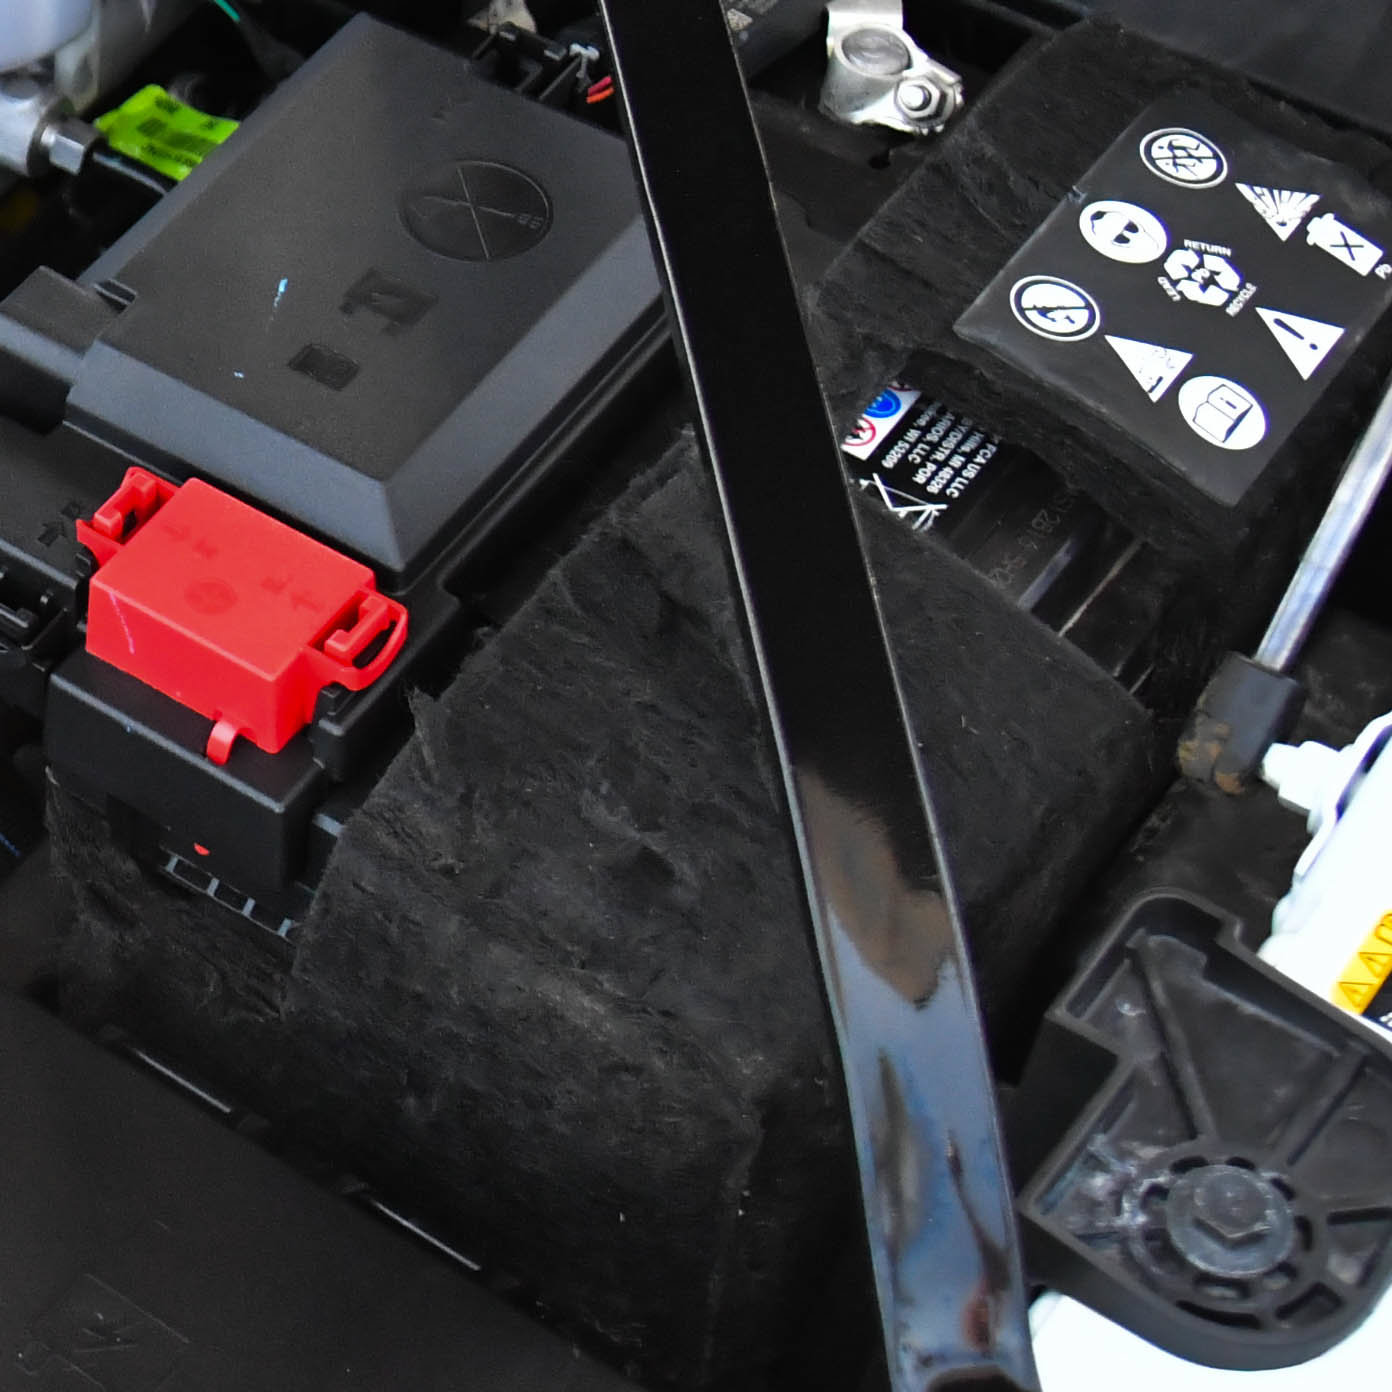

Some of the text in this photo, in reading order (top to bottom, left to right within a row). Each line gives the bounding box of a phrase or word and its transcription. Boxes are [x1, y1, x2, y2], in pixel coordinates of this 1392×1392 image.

[1183, 238, 1232, 257] RETURN
[908, 443, 929, 464] LLC
[912, 461, 937, 484] POR
[945, 443, 998, 499] FCA US LLC
